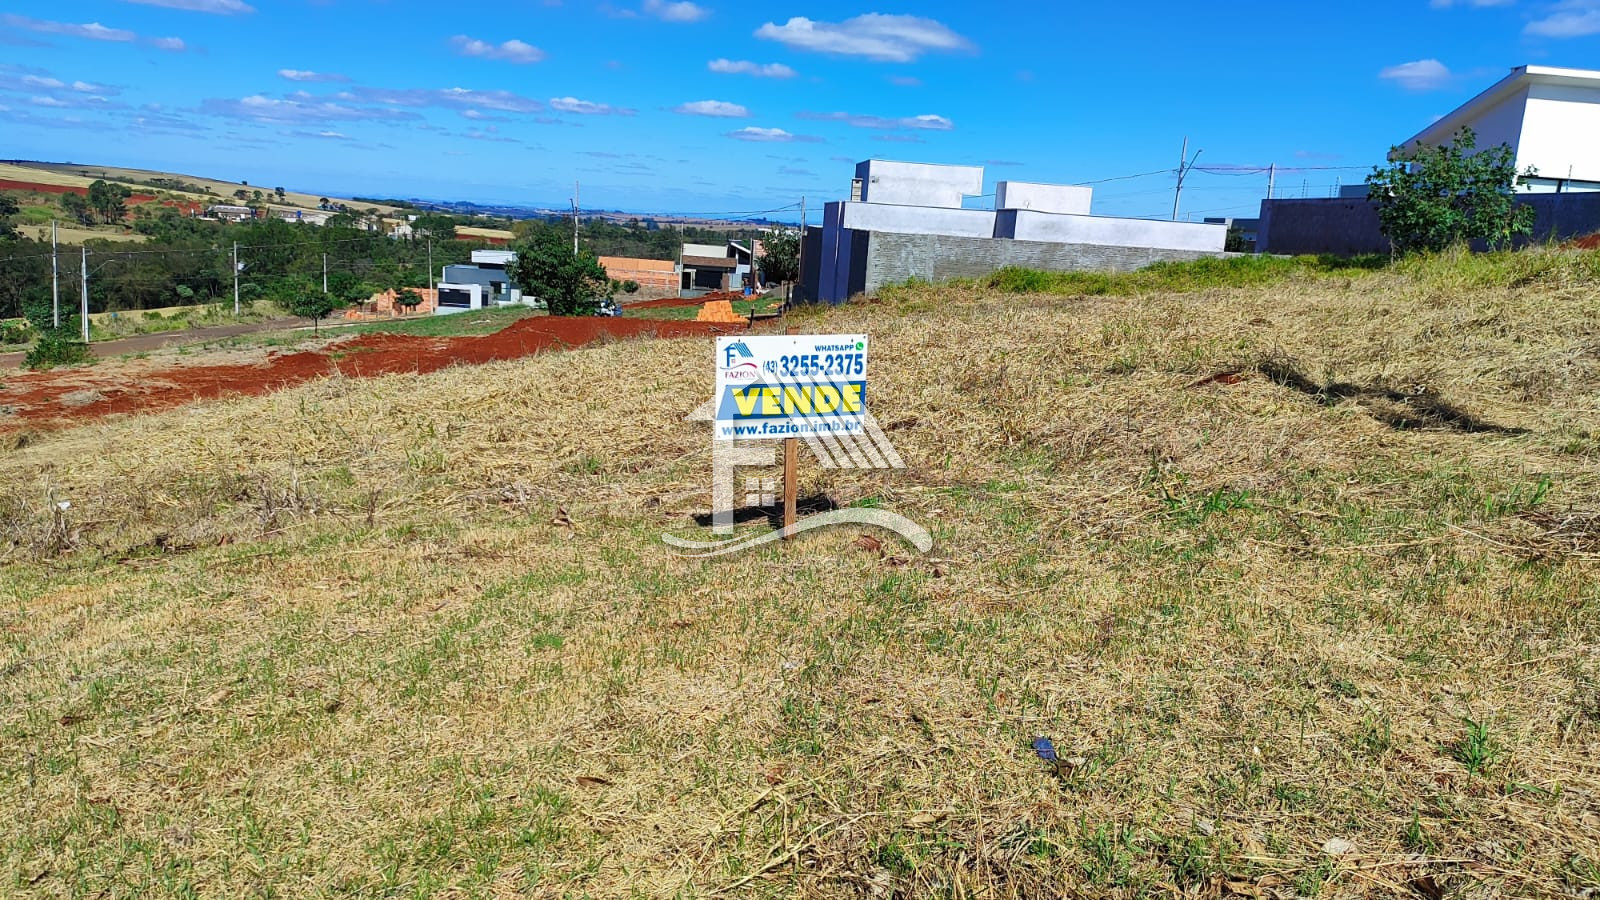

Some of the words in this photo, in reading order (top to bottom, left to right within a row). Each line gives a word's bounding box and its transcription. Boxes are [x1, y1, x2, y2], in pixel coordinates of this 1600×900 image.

[763, 361, 778, 376] (43)
[780, 354, 863, 376] 3255-2375
[724, 371, 756, 379] FAZION
[733, 385, 861, 416] VENDE
[722, 421, 860, 435] www.fazion.imb.br
